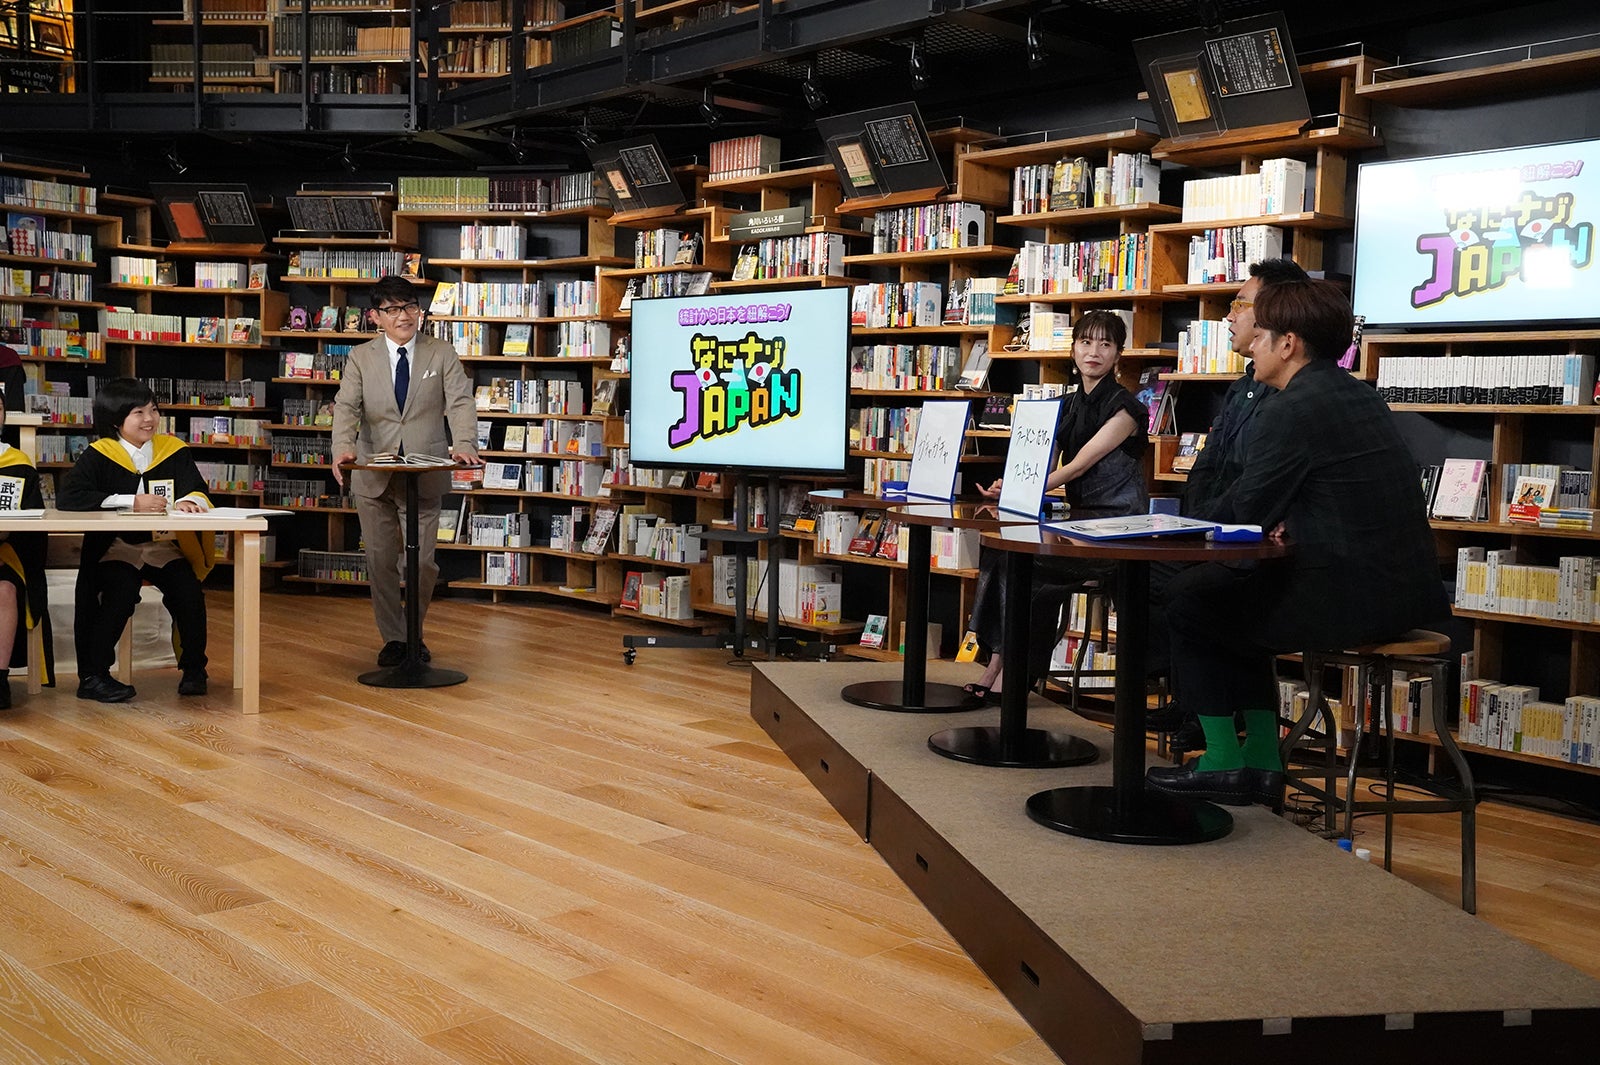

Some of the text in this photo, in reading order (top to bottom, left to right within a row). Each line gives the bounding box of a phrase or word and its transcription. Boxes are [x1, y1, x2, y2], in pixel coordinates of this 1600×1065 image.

[10, 68, 54, 83] Staff Only
[1221, 86, 1229, 95] 8
[692, 334, 784, 369] なにナゾ
[670, 373, 798, 446] JAPAN
